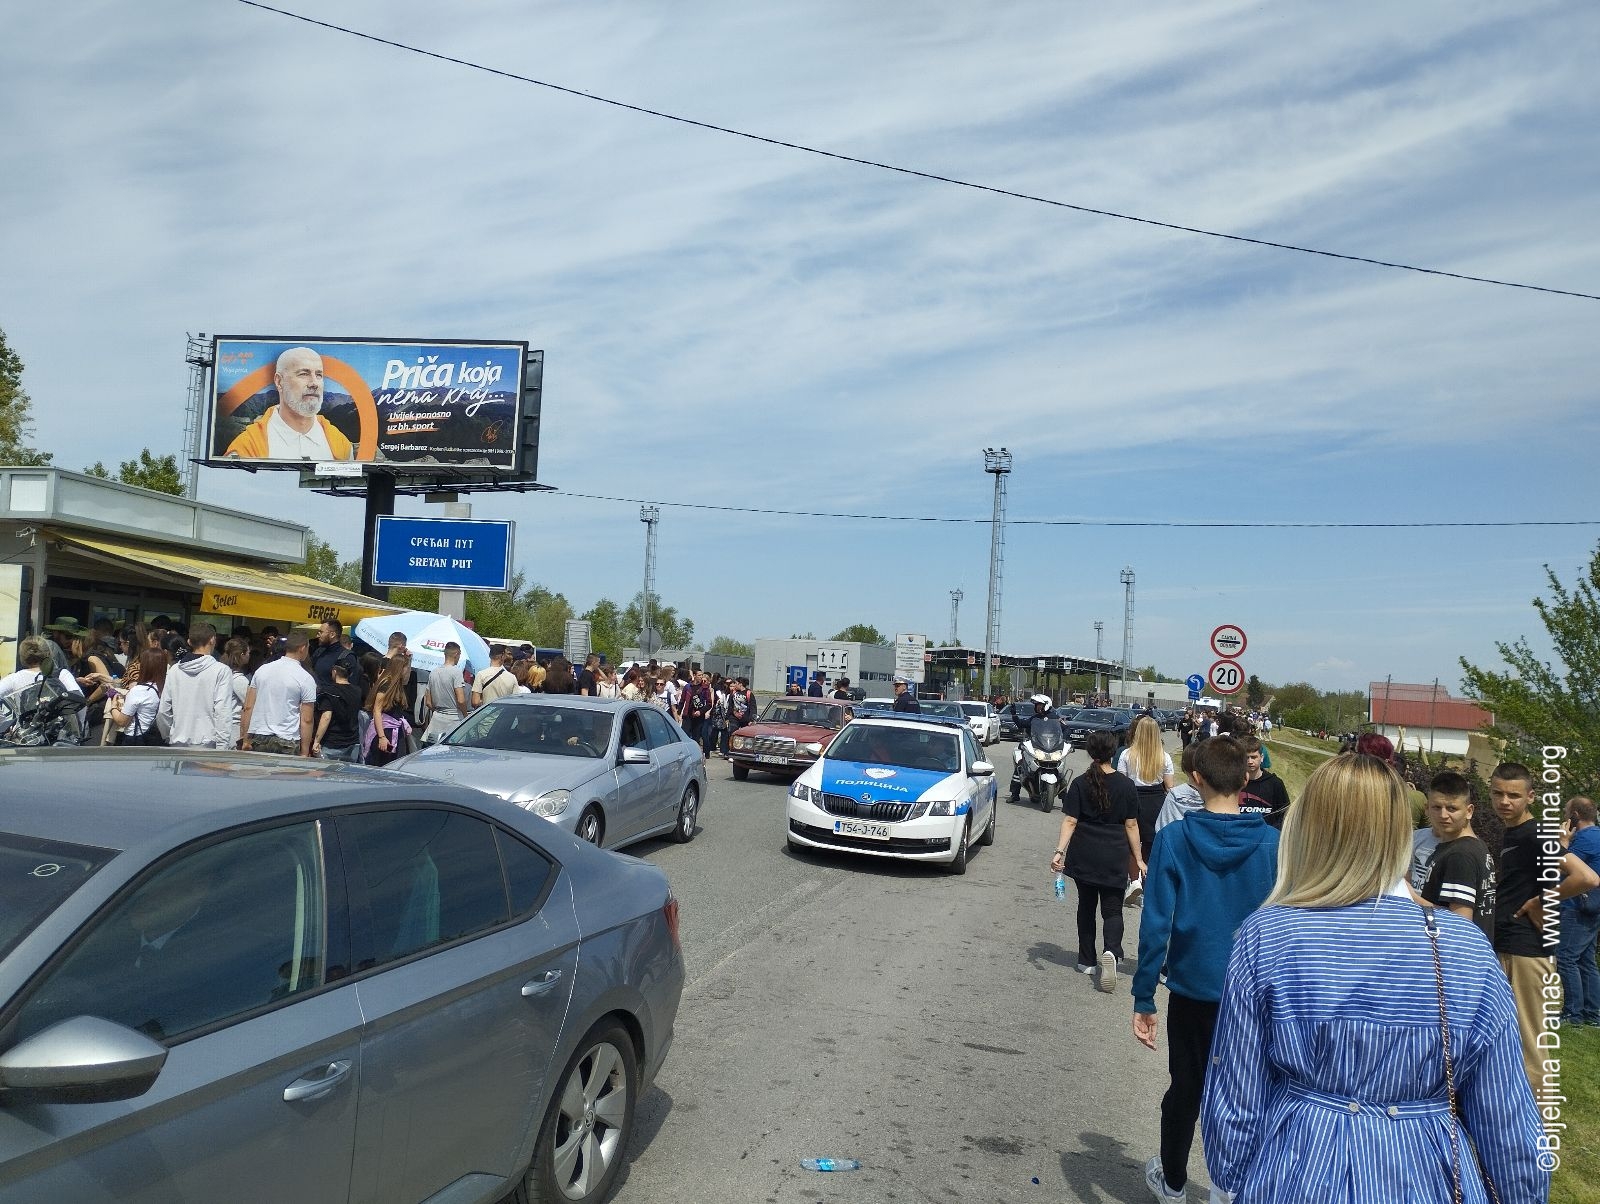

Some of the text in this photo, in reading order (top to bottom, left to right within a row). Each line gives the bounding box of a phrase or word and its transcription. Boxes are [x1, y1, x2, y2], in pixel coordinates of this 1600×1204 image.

[381, 355, 502, 390] Priča koja
[377, 389, 438, 405] nema
[389, 411, 451, 421] Uvijek ponosno
[412, 422, 434, 432] sport
[380, 443, 399, 451] Sergej
[454, 539, 473, 549] ПУТ
[409, 556, 472, 569] SRETAN PUT
[308, 604, 340, 620] SERGEJ
[794, 669, 804, 680] P
[1216, 667, 1237, 686] 20
[835, 779, 908, 793] ПОЛИЦИЈА
[841, 822, 888, 837] T54-J-746
